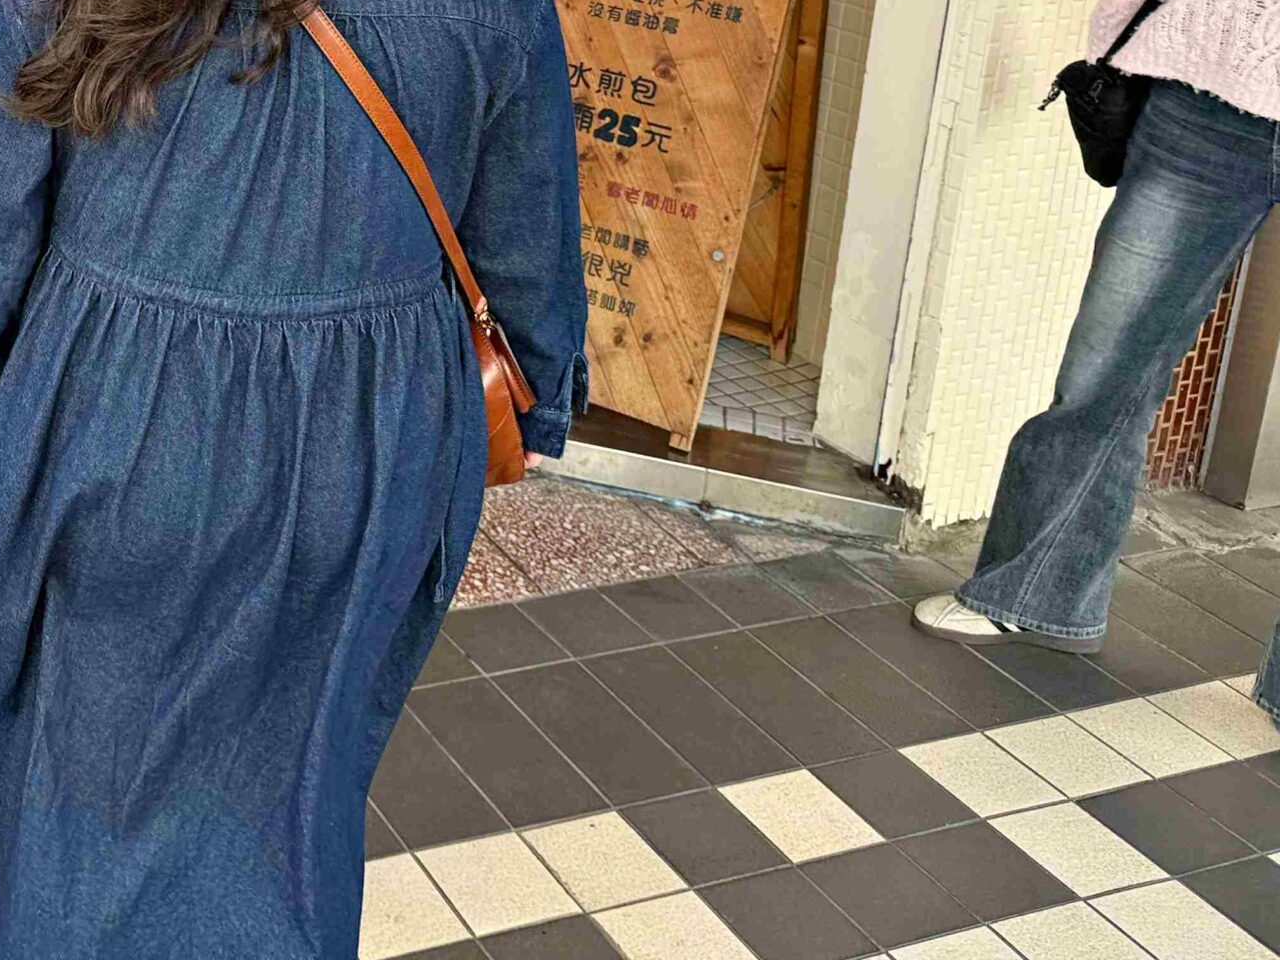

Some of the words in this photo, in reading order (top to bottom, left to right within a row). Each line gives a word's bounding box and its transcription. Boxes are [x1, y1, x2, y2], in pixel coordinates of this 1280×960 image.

[587, 1, 680, 34] 沒有醬油膏
[569, 62, 658, 106] 水煎包
